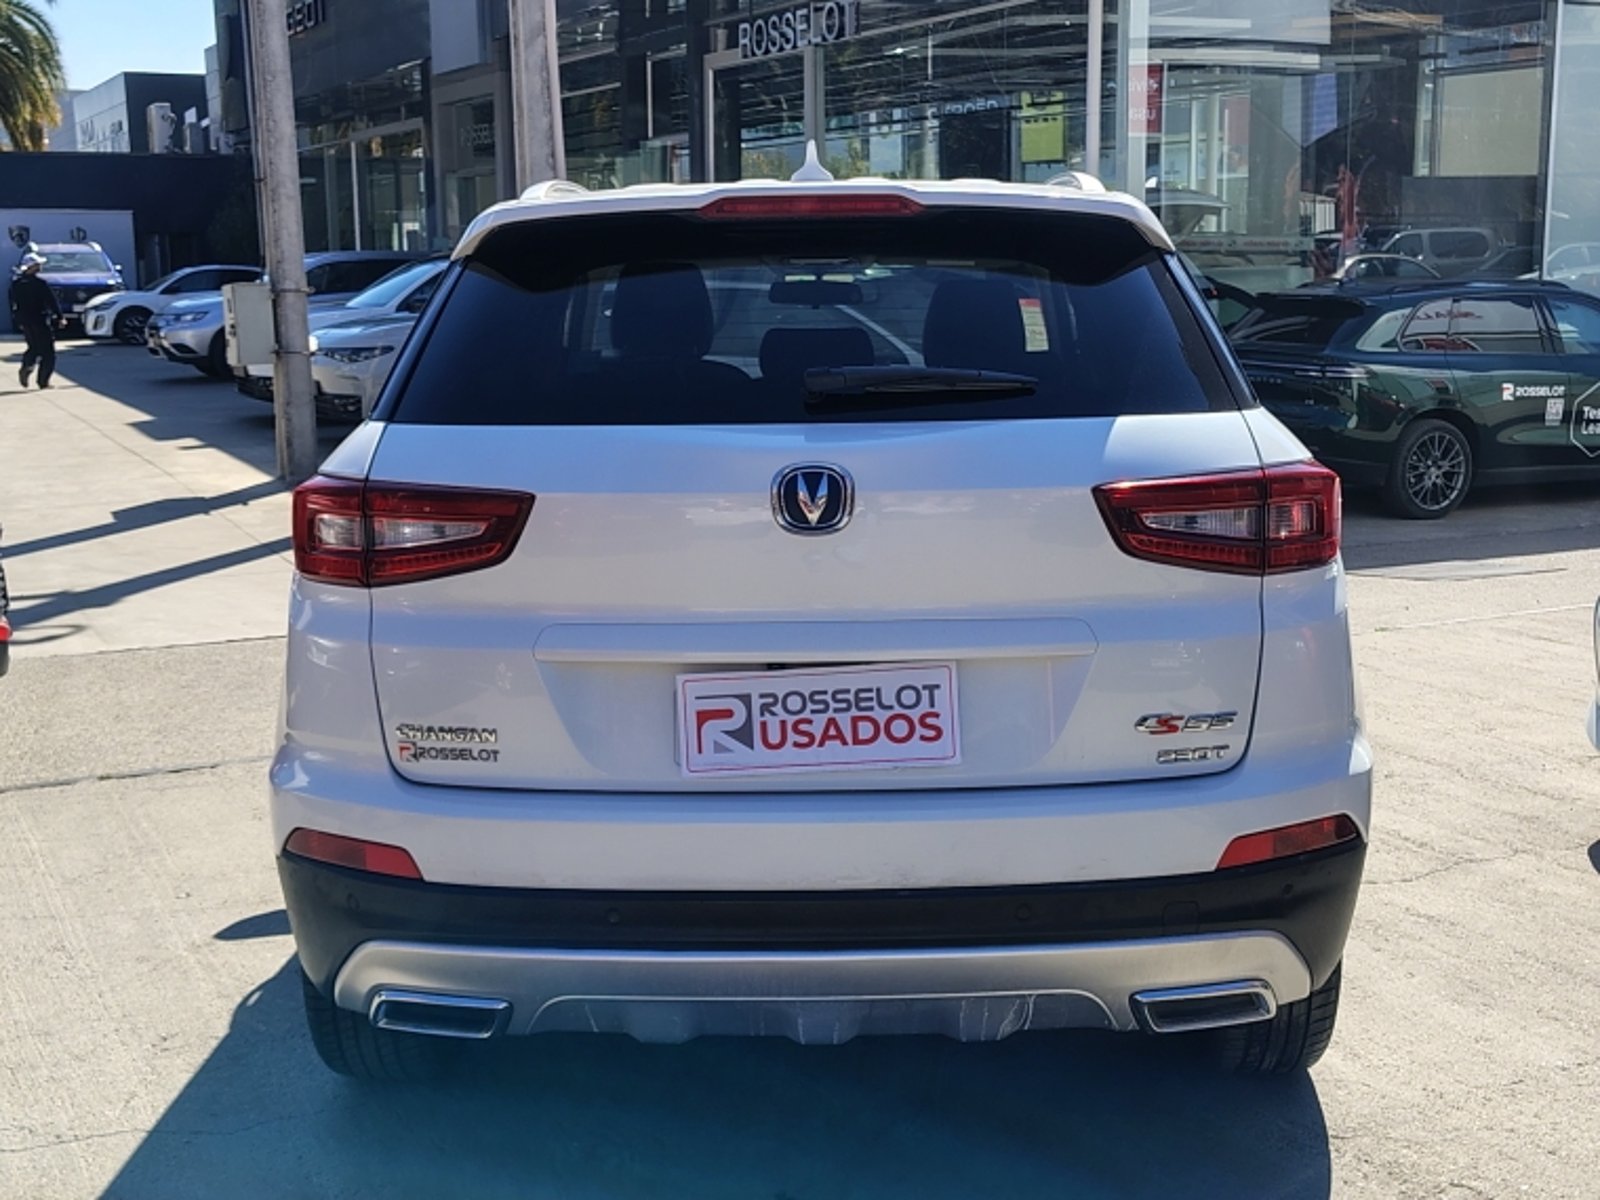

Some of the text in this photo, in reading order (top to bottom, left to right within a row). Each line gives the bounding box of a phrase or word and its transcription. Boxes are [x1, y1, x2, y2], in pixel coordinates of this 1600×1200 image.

[738, 0, 859, 59] ROSSELOT
[1515, 385, 1565, 397] ROSSELOT
[758, 684, 941, 718] ROSSELOT
[395, 723, 499, 743] CHANGAN
[760, 711, 944, 750] USADOS
[1134, 708, 1238, 735] CS55
[417, 746, 500, 763] ROSSELOT
